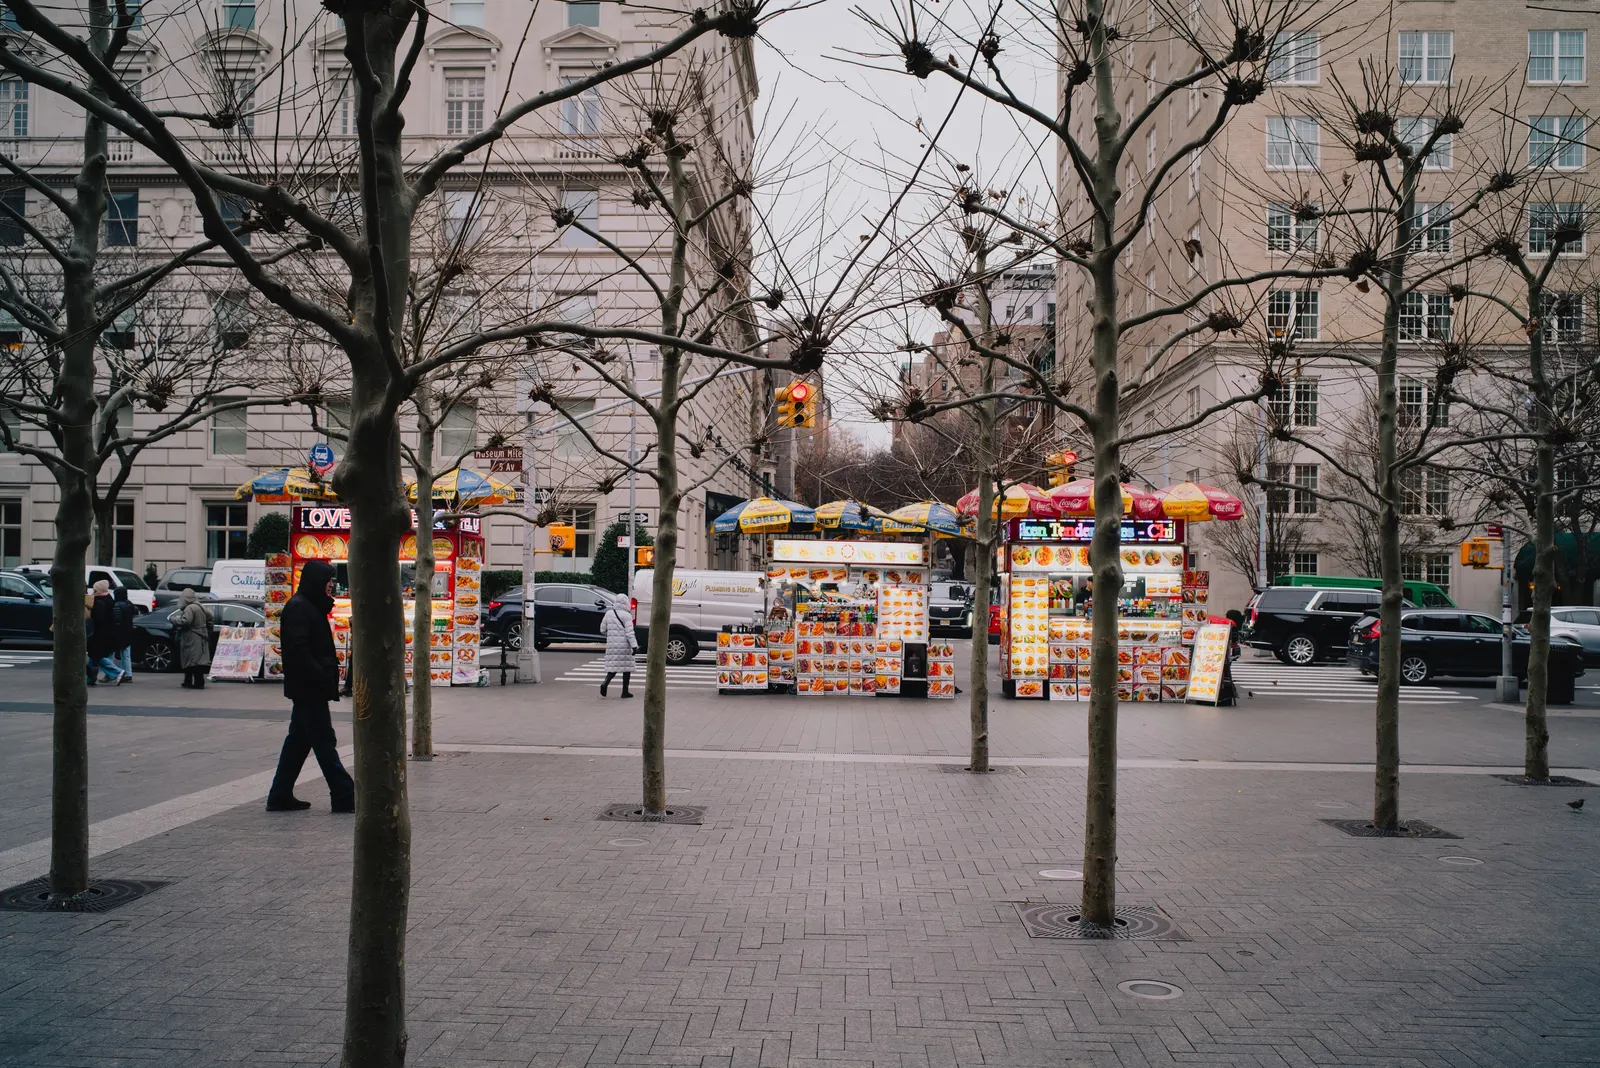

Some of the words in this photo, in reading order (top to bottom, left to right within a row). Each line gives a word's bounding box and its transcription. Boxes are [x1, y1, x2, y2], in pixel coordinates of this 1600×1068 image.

[475, 449, 505, 458] Museum
[507, 449, 522, 458] Mile
[288, 485, 318, 496] SABRE
[1059, 498, 1082, 508] Coca-Cola
[1215, 502, 1235, 512] Coca-Cola
[742, 513, 788, 526] SABRETT
[231, 575, 266, 590] Culliga
[705, 585, 731, 593] PLUMBING
[737, 586, 759, 594] HEATIN
